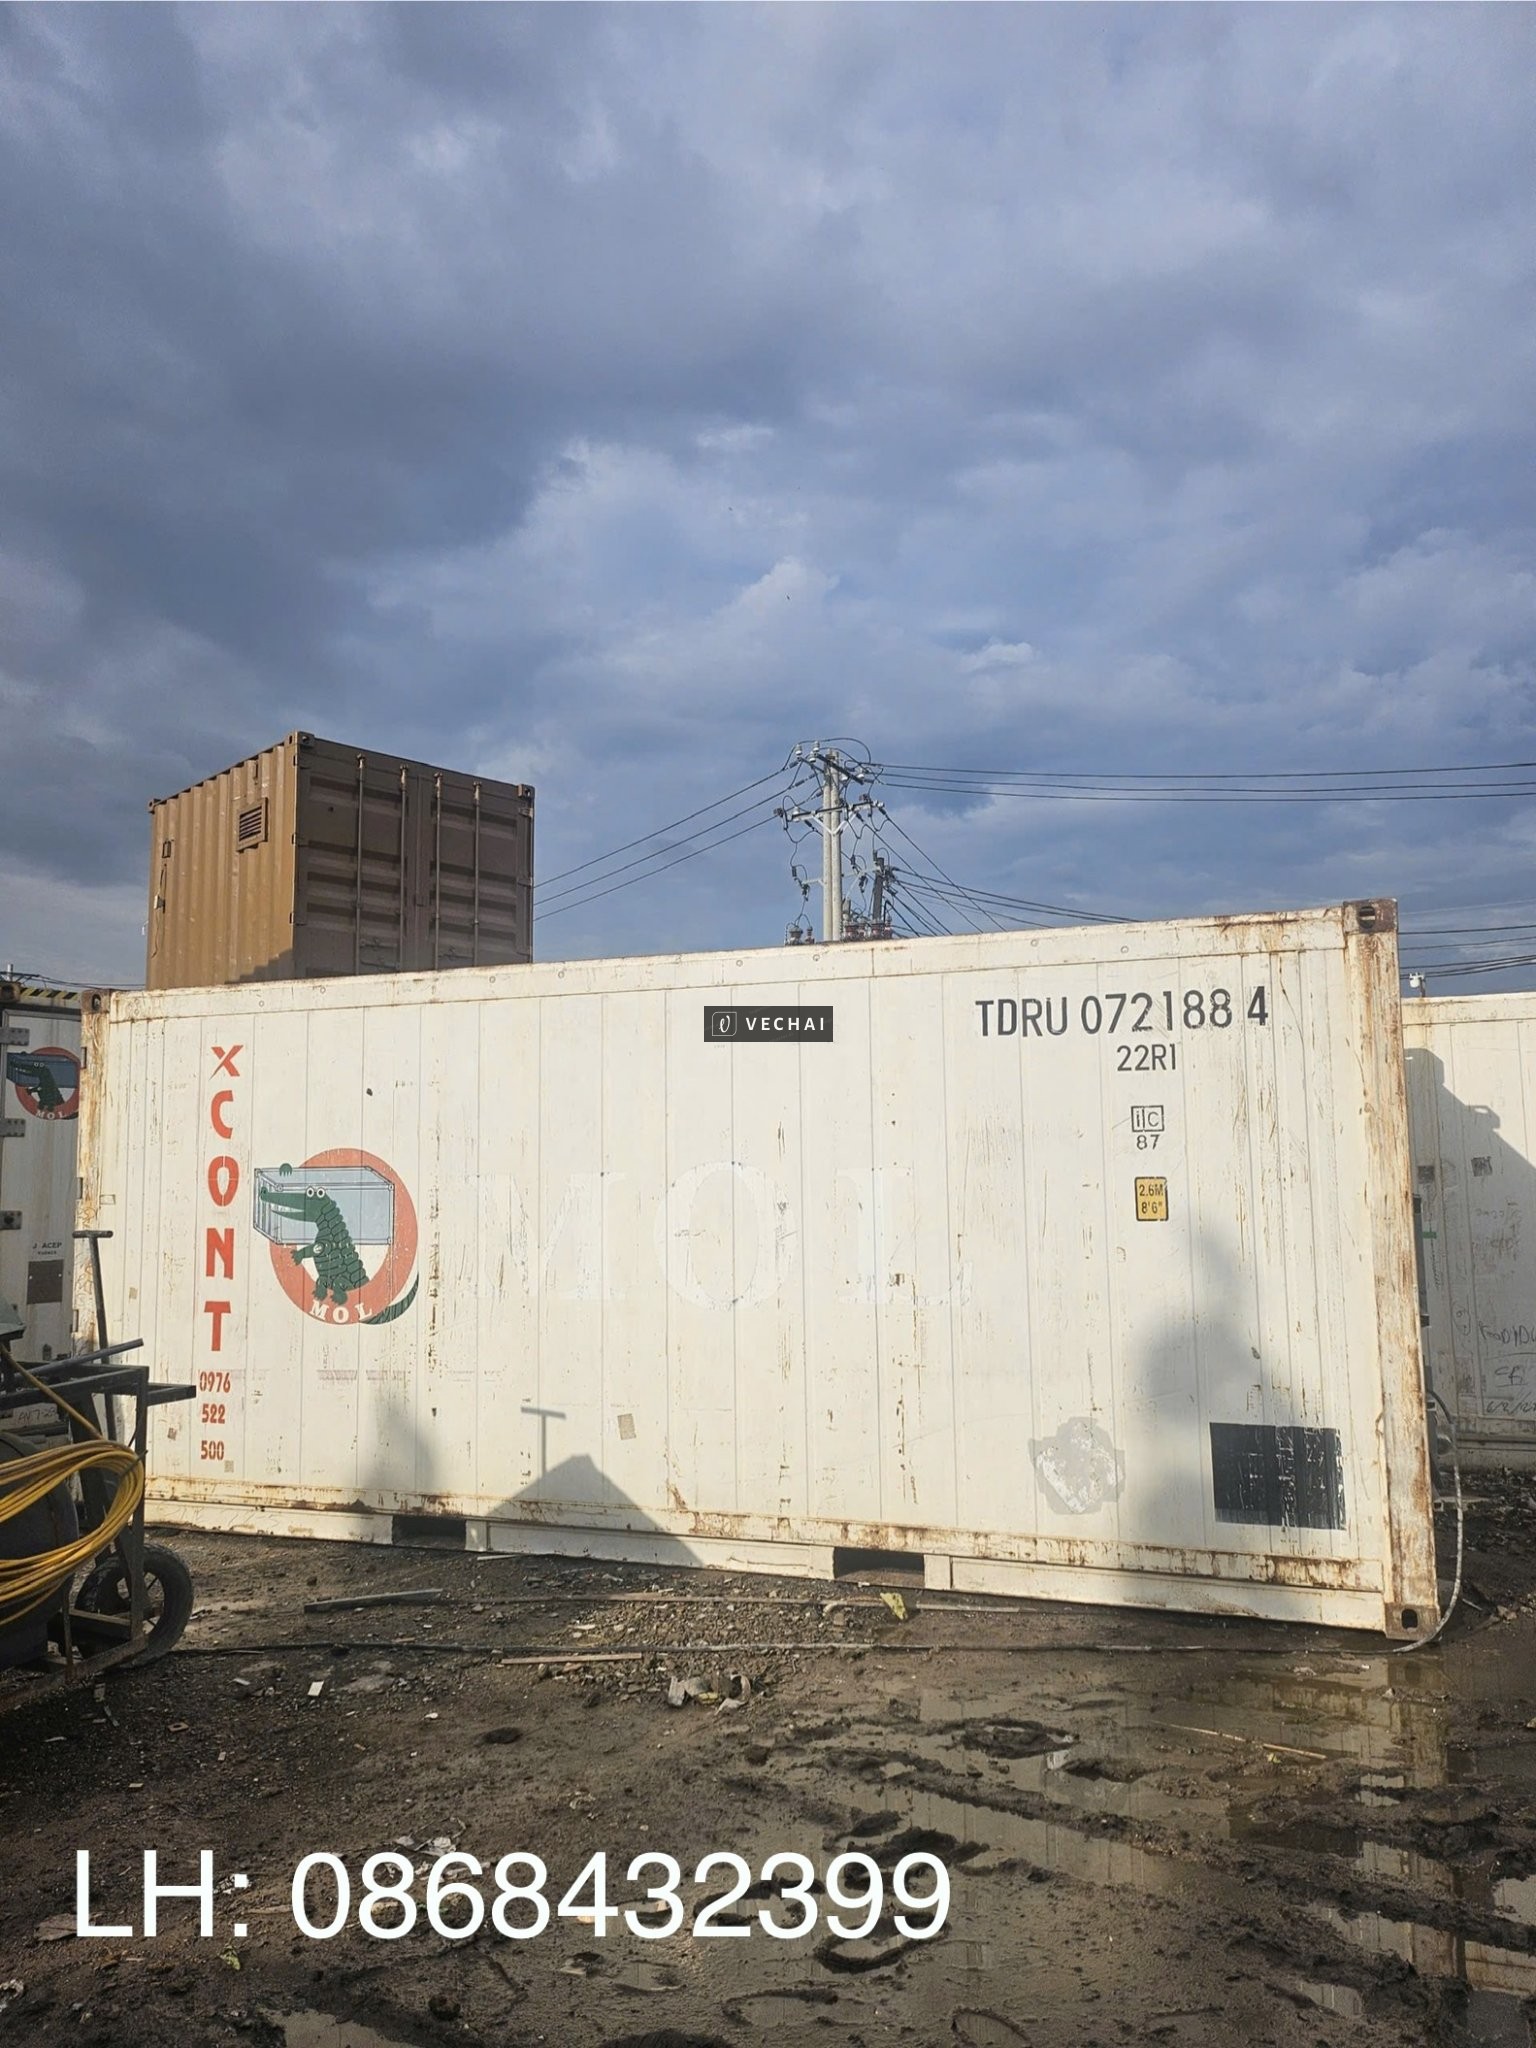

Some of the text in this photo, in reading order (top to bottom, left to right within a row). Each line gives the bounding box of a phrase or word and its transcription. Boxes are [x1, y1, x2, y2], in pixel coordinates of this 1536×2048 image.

[975, 986, 1269, 1037] TDRU 072188 4
[1116, 1043, 1177, 1072] 22R1
[35, 1110, 66, 1120] MOL
[1136, 1134, 1161, 1150] 87
[204, 1044, 244, 1352] XCONT
[1138, 1183, 1164, 1197] 2.6M
[309, 1299, 373, 1324] MOL
[199, 1371, 231, 1394] 0976
[201, 1403, 226, 1425] 522
[200, 1439, 225, 1461] 500
